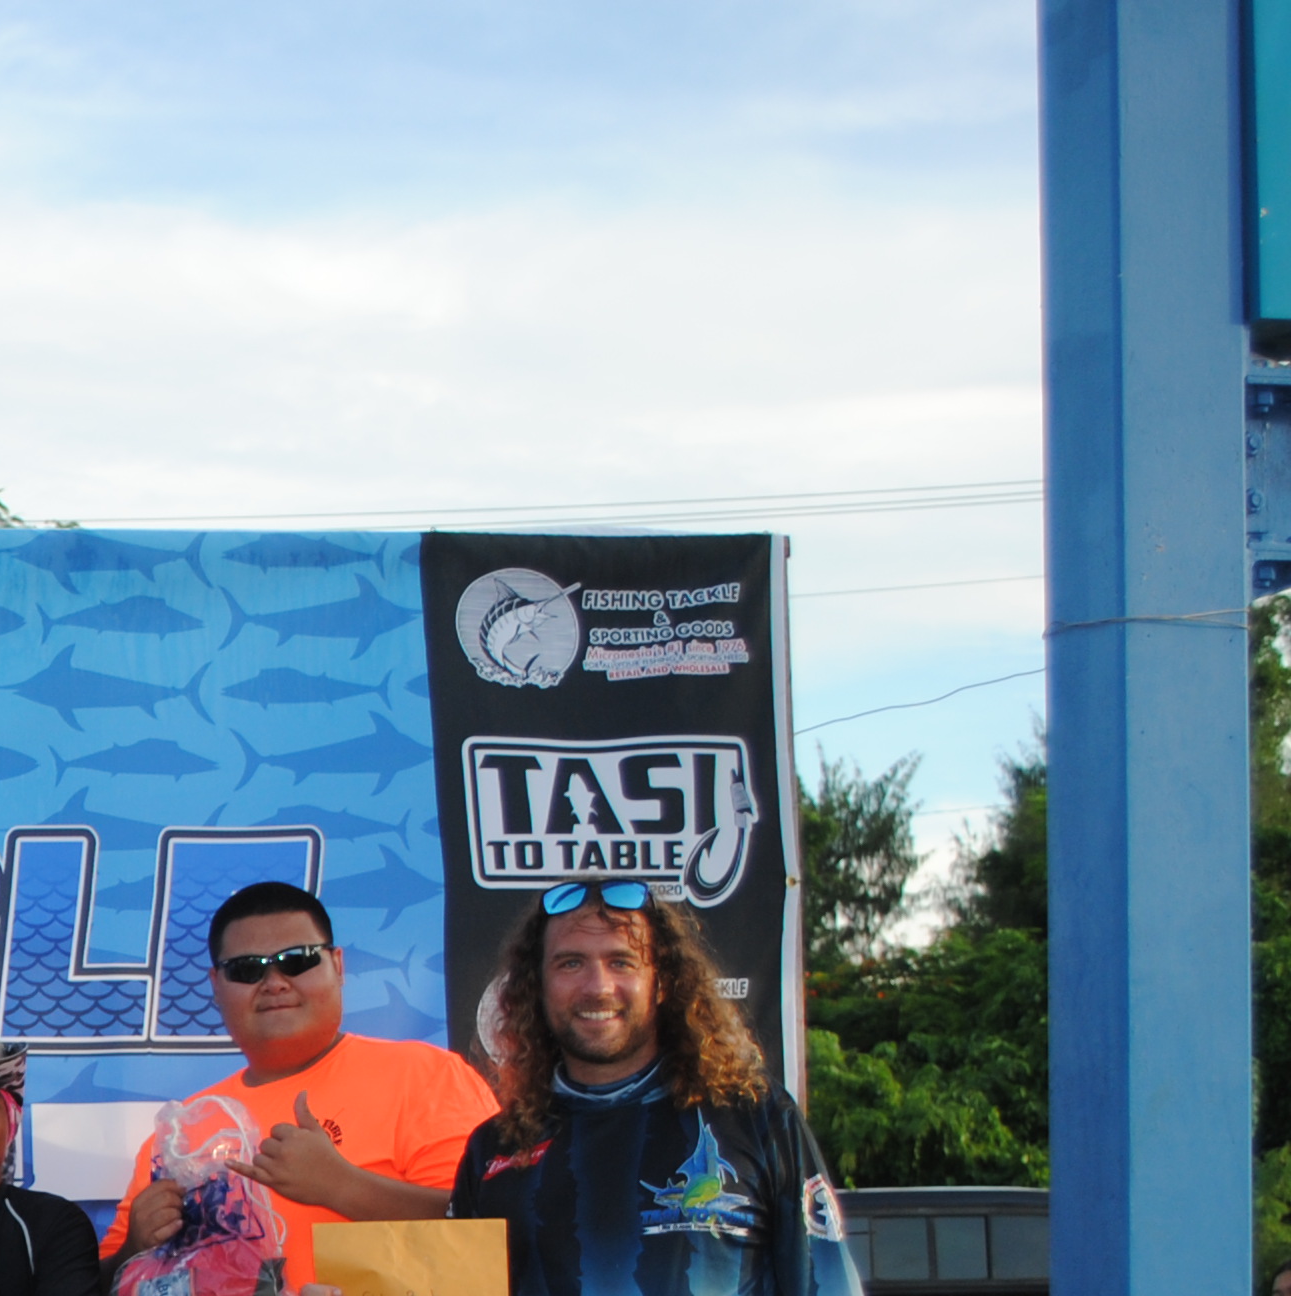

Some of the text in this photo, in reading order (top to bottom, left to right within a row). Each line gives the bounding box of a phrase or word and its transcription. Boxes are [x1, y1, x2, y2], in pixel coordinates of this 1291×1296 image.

[584, 584, 739, 609] FISHING TACKLE
[655, 613, 667, 625] &
[591, 622, 733, 643] SPORTING GOODS
[479, 754, 717, 834] TASI
[486, 841, 684, 870] TO TABLE
[720, 981, 747, 995] KLE
